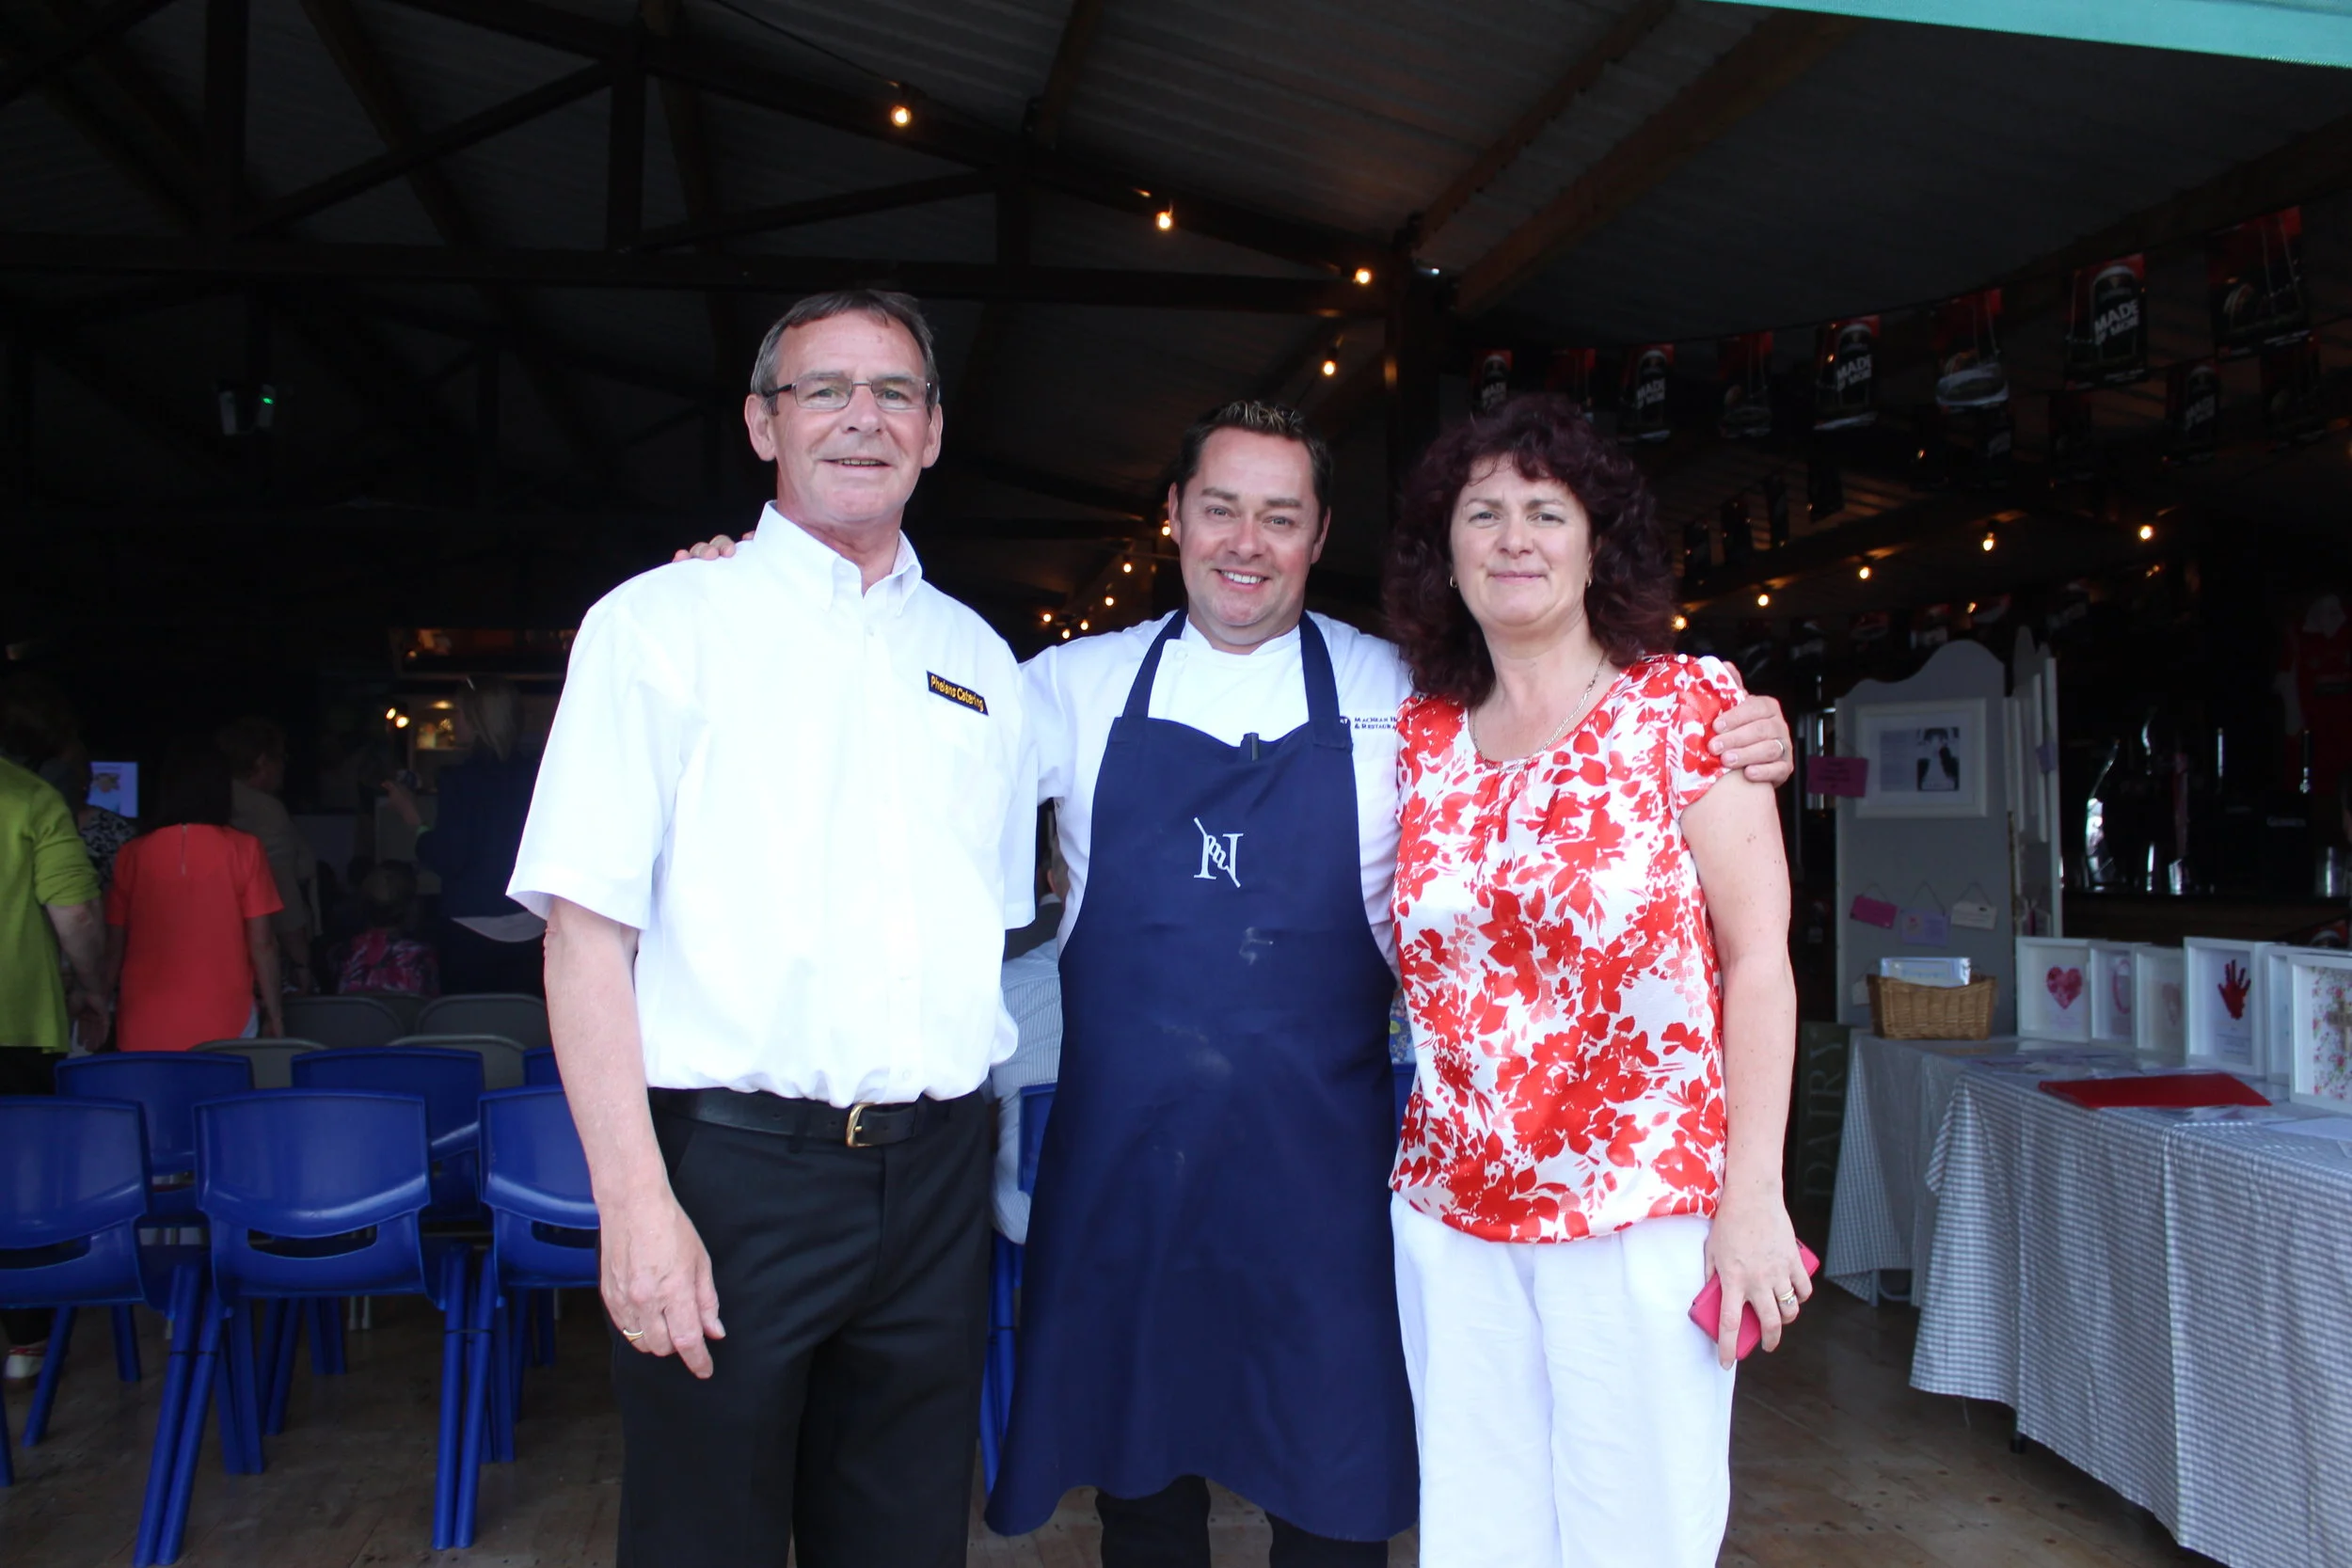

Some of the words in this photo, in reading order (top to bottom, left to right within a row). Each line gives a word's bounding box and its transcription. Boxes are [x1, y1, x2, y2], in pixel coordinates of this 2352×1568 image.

[2094, 298, 2138, 333] MADE
[1836, 355, 1872, 380] MADE
[930, 674, 957, 698] Phelans
[957, 688, 984, 712] Catering
